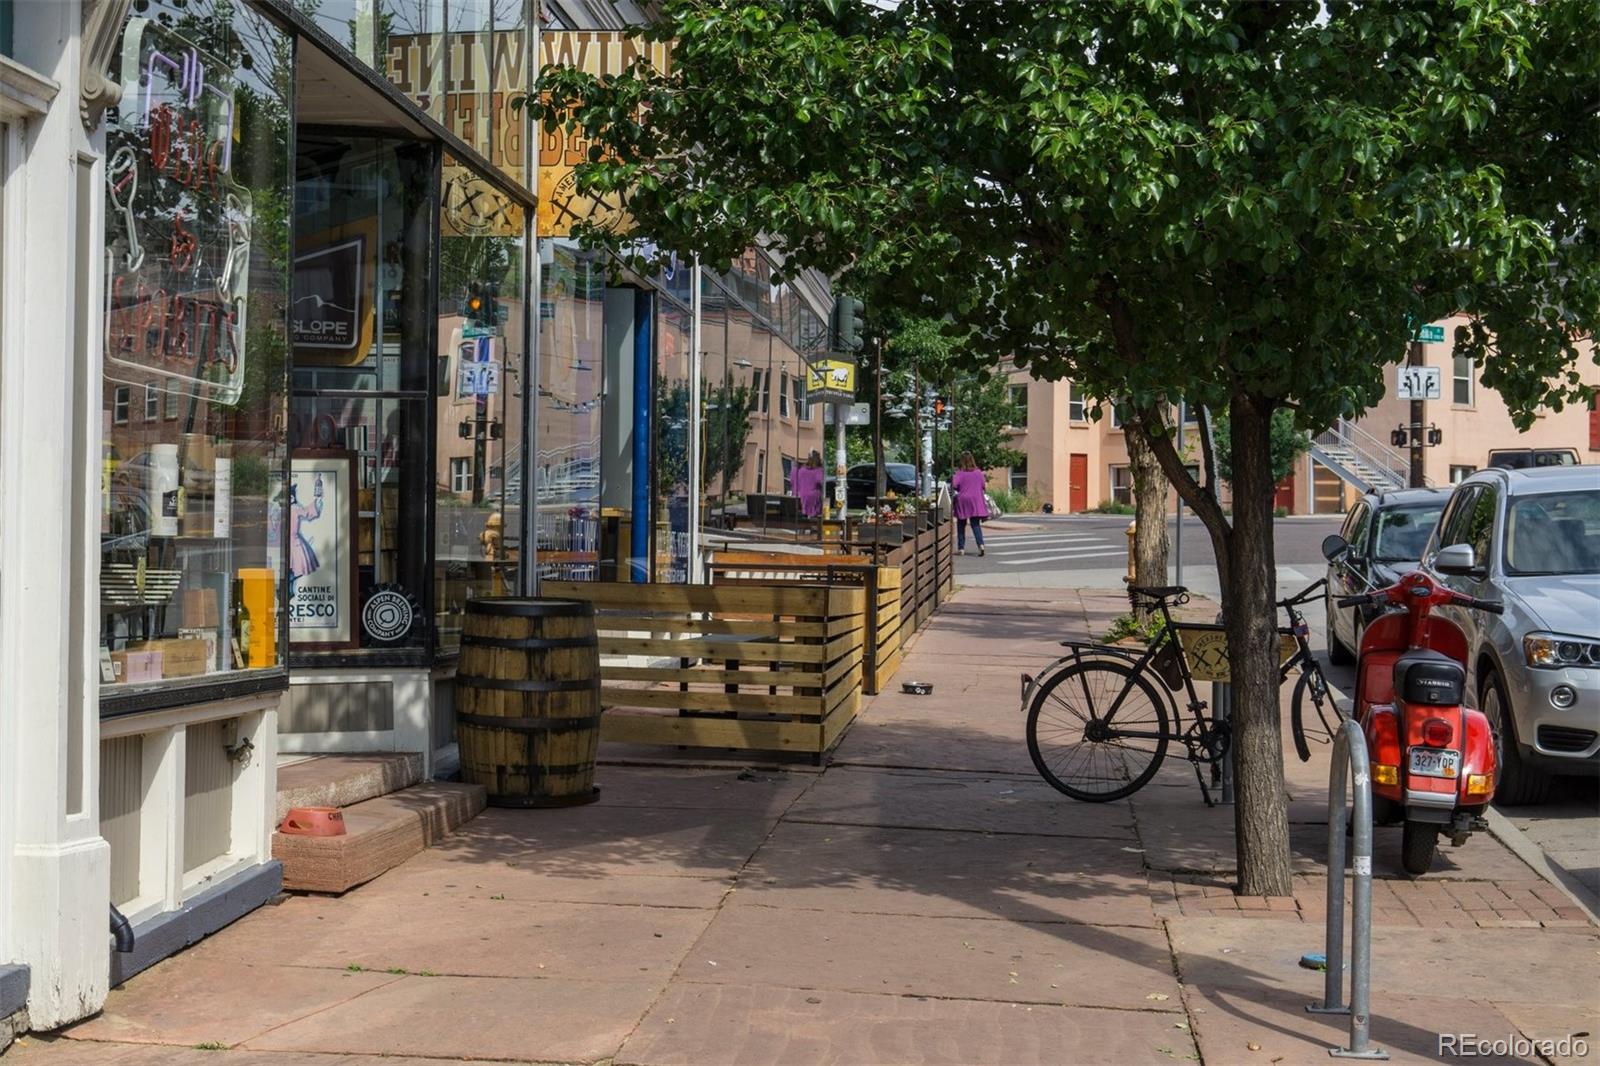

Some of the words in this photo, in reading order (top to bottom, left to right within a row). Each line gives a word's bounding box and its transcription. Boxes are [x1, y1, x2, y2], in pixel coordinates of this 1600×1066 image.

[298, 585, 332, 594] CANTINE
[297, 593, 326, 602] SOCIALI
[370, 595, 391, 610] ASPEN
[391, 596, 409, 625] BREWING
[367, 619, 395, 637] COMPANY
